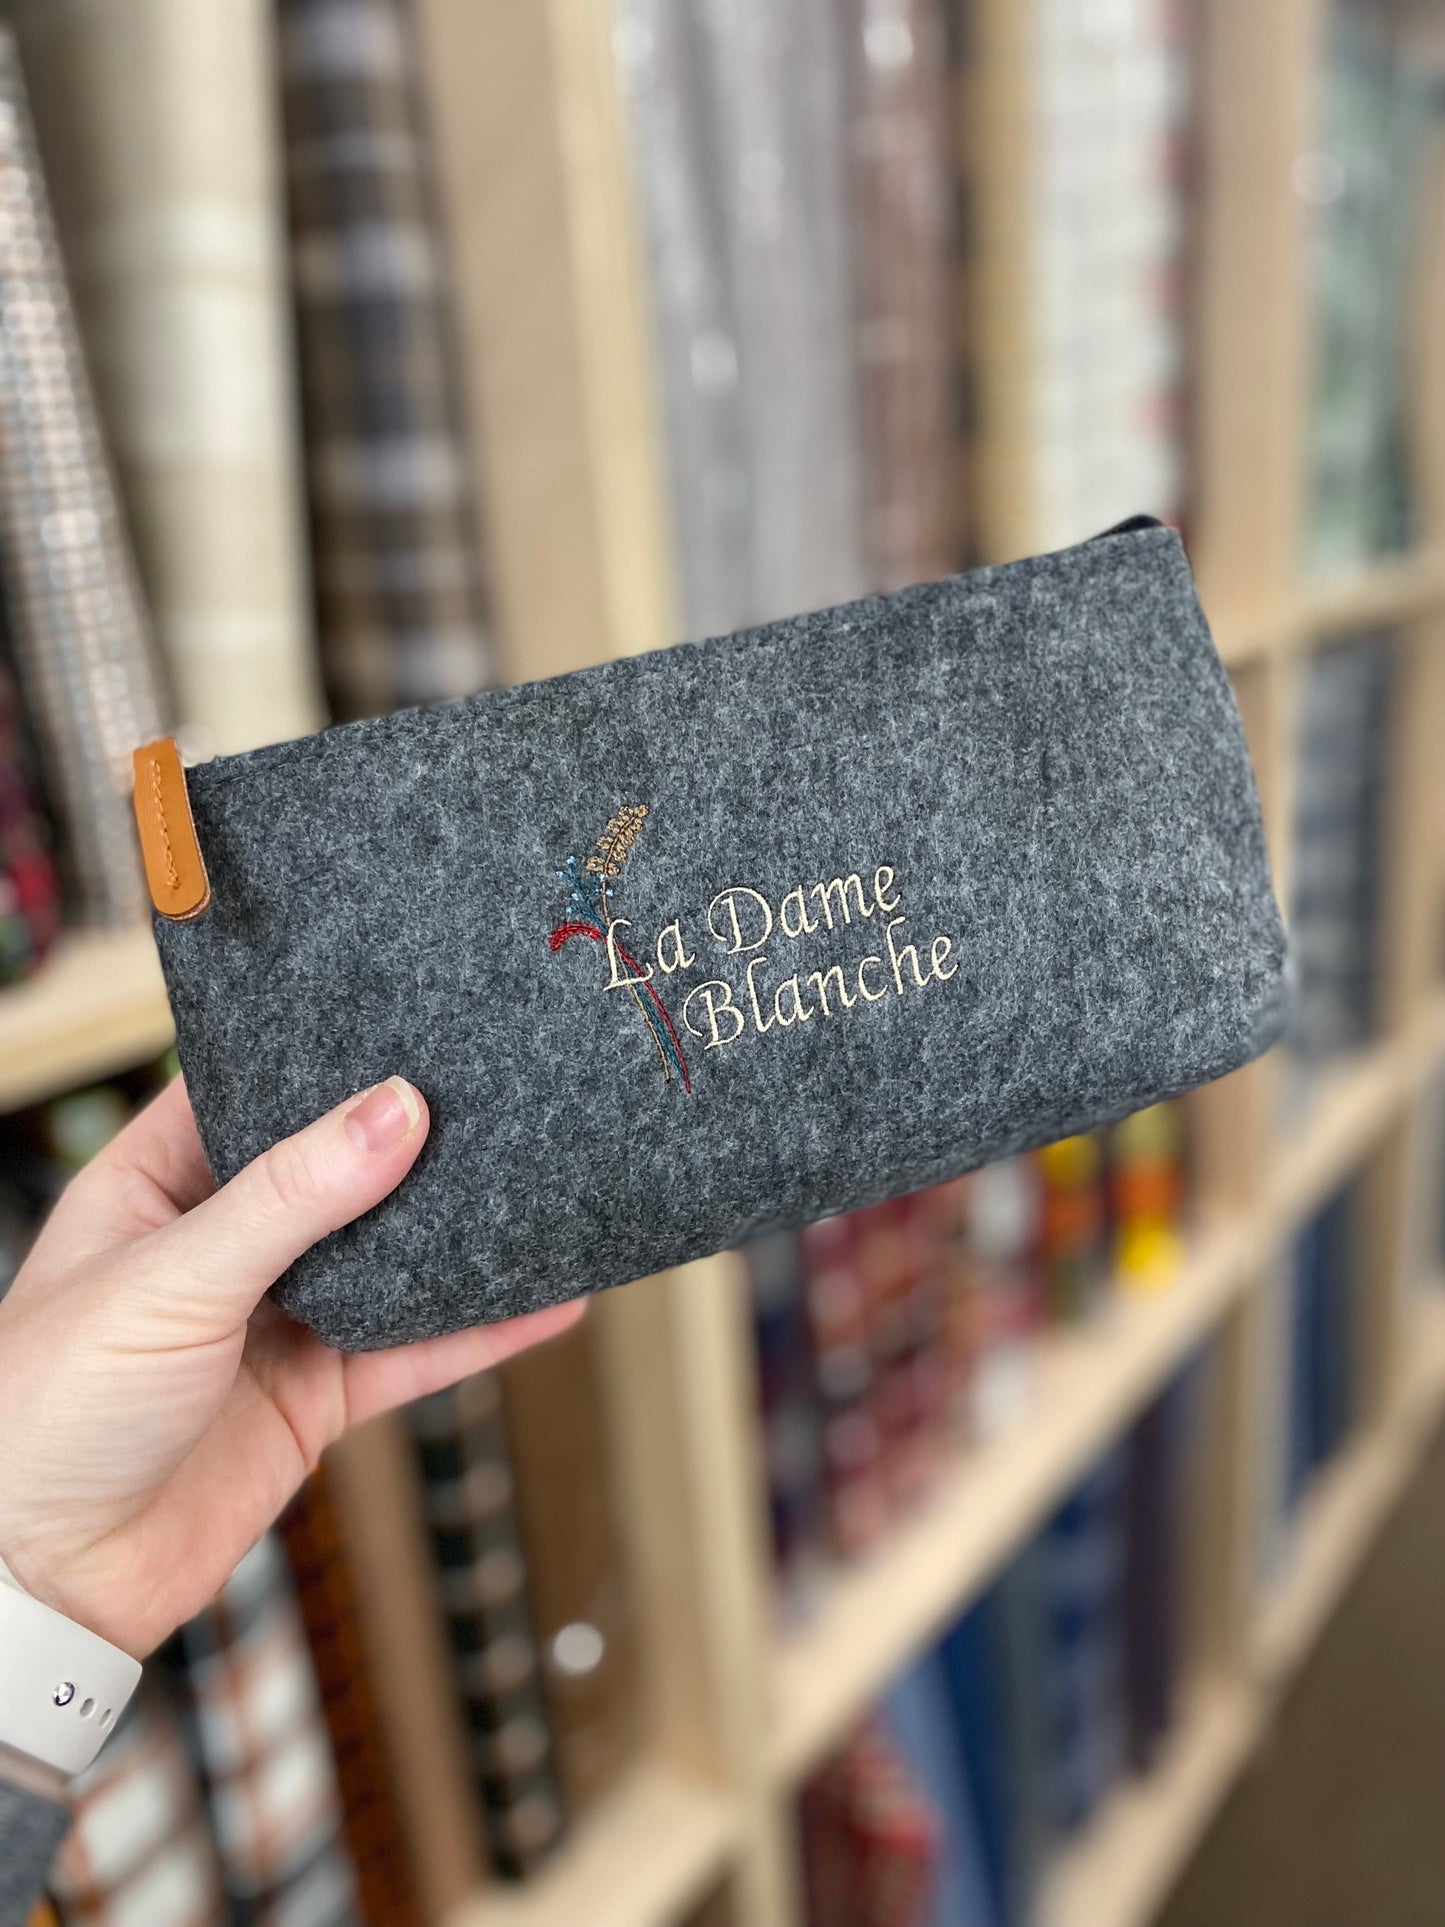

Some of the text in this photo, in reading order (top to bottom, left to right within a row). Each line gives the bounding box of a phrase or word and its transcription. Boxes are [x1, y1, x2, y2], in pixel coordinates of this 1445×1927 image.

[603, 865, 901, 992] La Dame
[682, 916, 959, 1051] Blanche
